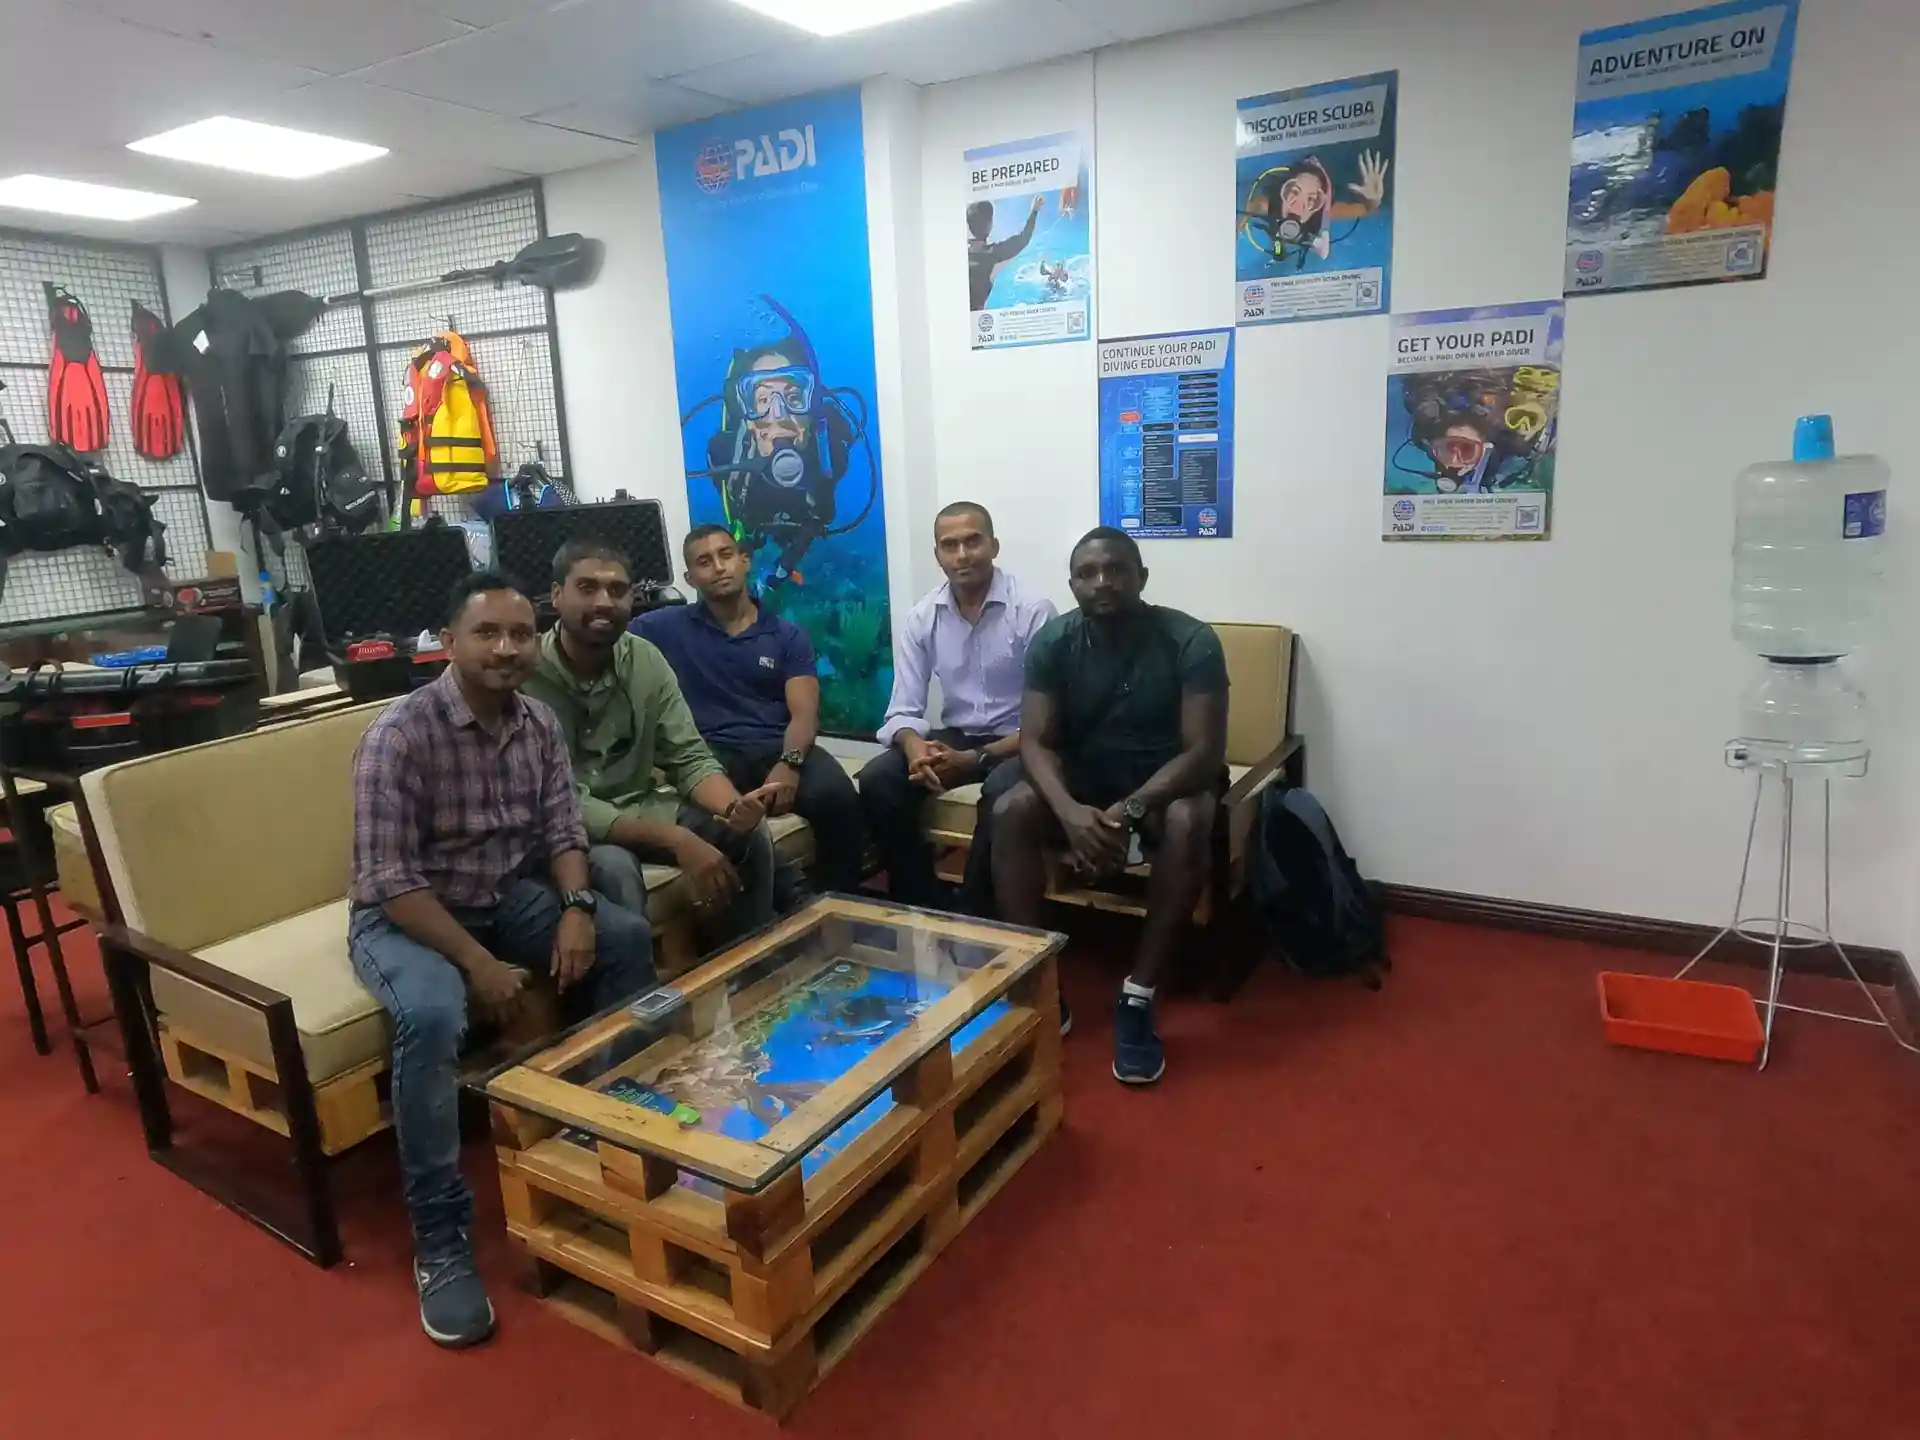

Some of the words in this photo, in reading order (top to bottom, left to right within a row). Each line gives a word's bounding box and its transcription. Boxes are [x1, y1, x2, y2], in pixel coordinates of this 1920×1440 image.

[1590, 34, 1723, 76] ADVENTURE
[1730, 26, 1766, 48] ON
[1322, 101, 1375, 122] SCUBA
[734, 124, 817, 181] PADI
[972, 170, 988, 184] BE
[991, 158, 1060, 181] PREPARED
[1102, 345, 1155, 360] CONTINUE
[1158, 342, 1187, 355] YOUR
[1190, 340, 1216, 351] PADI
[1397, 337, 1431, 353] GET
[1435, 333, 1485, 350] YOUR
[1491, 329, 1534, 346] PADI
[1103, 359, 1138, 372] DIVING
[1141, 355, 1202, 369] EDUCATION
[1436, 353, 1453, 361] PADI
[1455, 352, 1476, 360] OPEN
[1478, 350, 1505, 358] WATER
[1506, 348, 1530, 356] DIVER
